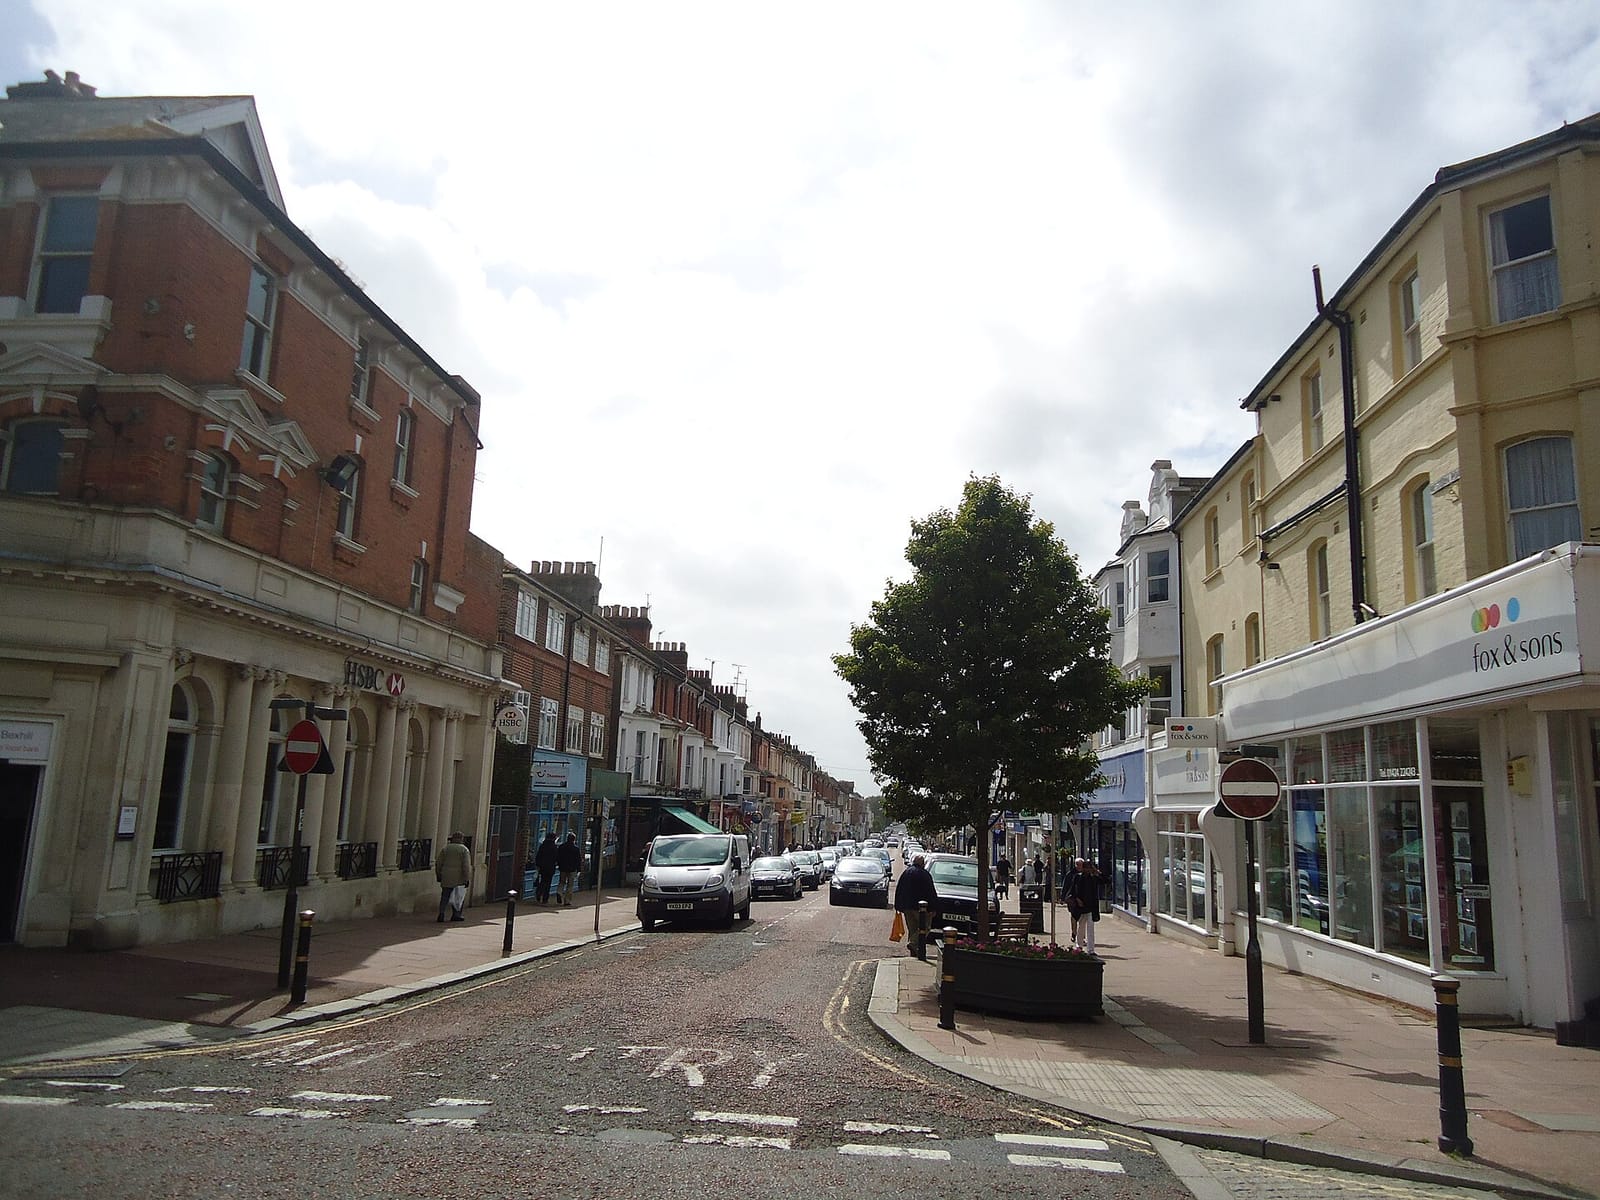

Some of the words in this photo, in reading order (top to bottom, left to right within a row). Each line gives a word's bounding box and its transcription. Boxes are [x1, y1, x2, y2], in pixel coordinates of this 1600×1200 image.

[1473, 642, 1501, 673] fox
[1503, 634, 1517, 666] &
[1520, 631, 1563, 662] sons
[344, 661, 385, 692] HSBC
[499, 719, 522, 728] HSBC
[1184, 732, 1191, 741] &
